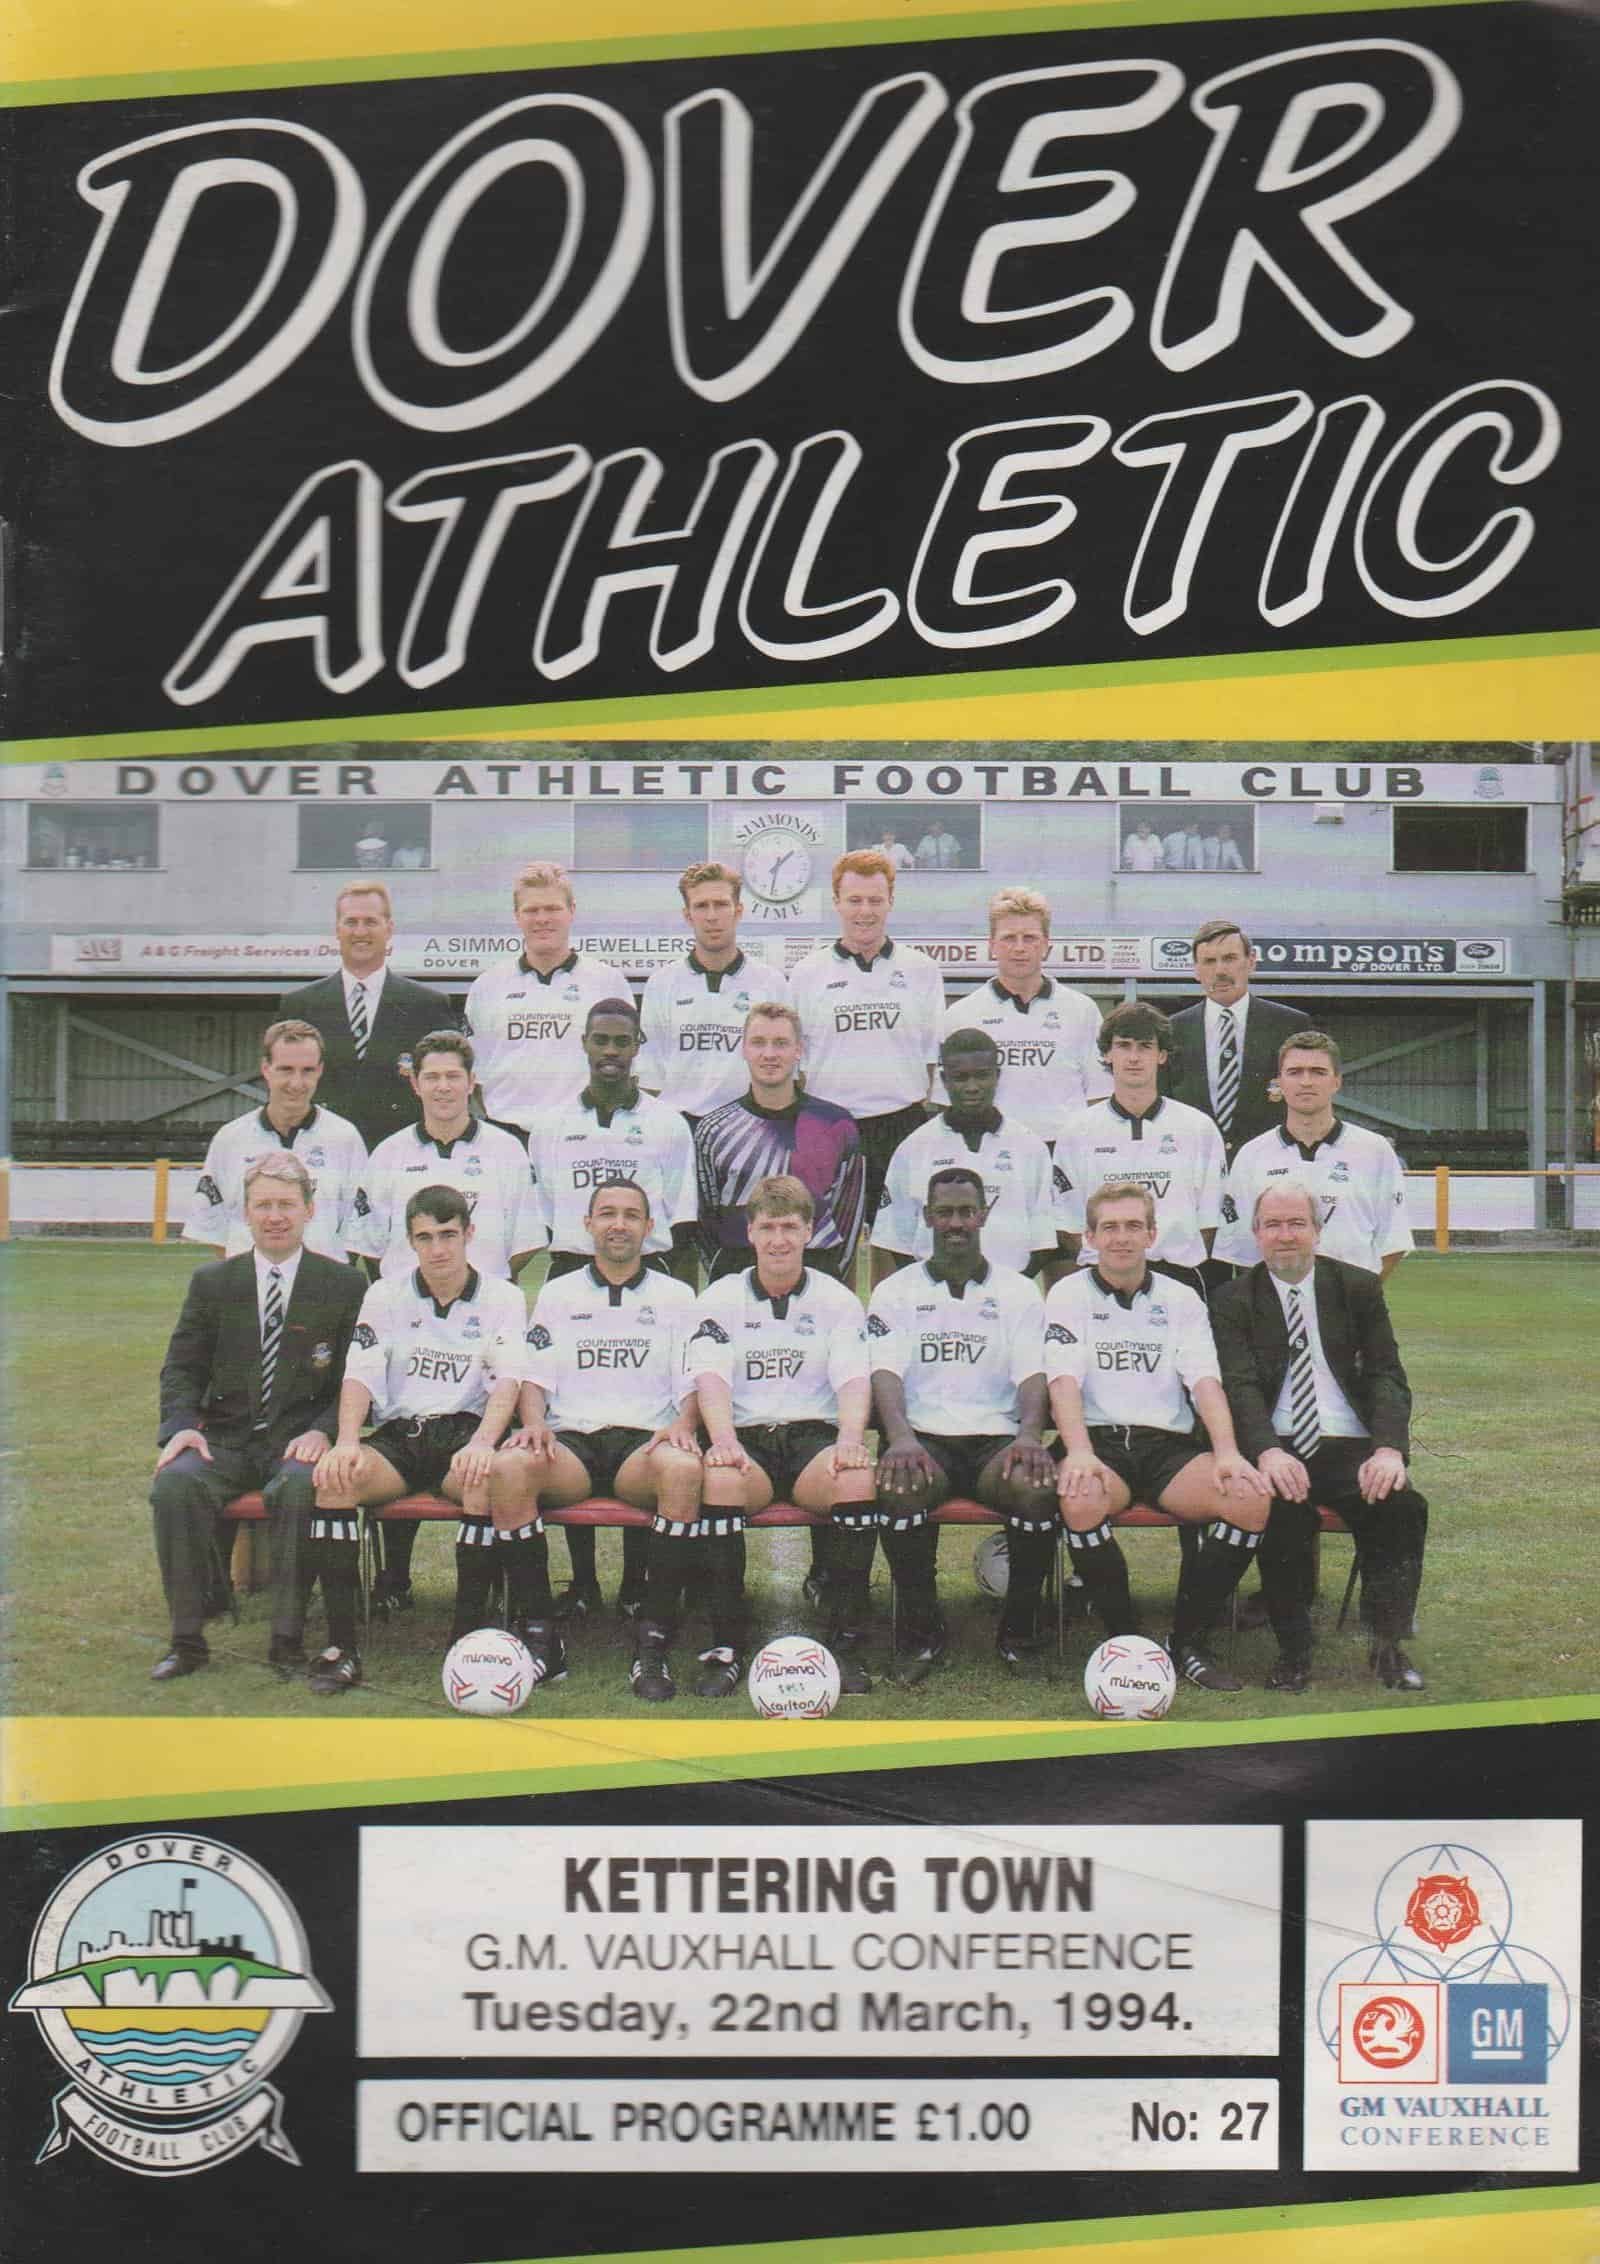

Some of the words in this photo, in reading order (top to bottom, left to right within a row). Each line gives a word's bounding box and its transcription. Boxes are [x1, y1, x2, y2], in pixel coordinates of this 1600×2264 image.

[49, 39, 1461, 447] DOVER
[163, 379, 1560, 705] ATHLETIC
[116, 765, 378, 796] DOVER
[434, 765, 786, 795] ATHLETIC
[834, 765, 1192, 796] FOOTBALL
[1240, 766, 1425, 797] CLUB
[736, 813, 821, 843] SIMMONDS
[752, 901, 803, 920] TIME
[183, 944, 241, 960] Freight
[244, 944, 311, 958] Services
[424, 938, 441, 952] A
[448, 938, 521, 952] SIMMO
[575, 938, 697, 953] JEWELLERS
[1064, 946, 1105, 962] LTD
[1249, 940, 1444, 969] hompson's
[424, 958, 480, 968] DOVER
[1350, 963, 1367, 972] OF
[1370, 963, 1411, 972] DOVER
[508, 1021, 571, 1040] DERV
[835, 1011, 900, 1033] DERV
[680, 1032, 742, 1052] DERV
[577, 1348, 649, 1369] DERV
[921, 1341, 986, 1364] DERV
[1096, 1350, 1161, 1373] DERV
[770, 1700, 816, 1712] carlton
[104, 1841, 233, 1871] DOVER
[565, 1857, 896, 1914] KETTERING
[925, 1857, 1094, 1914] TOWN
[466, 1933, 567, 1971] G.M.
[585, 1933, 836, 1971] VAUXHALL
[853, 1933, 1194, 1971] CONFERENCE
[463, 1991, 689, 2041] Tuesday,
[712, 1991, 838, 2032] 22nd
[861, 1991, 1030, 2040] March,
[1054, 1991, 1193, 2032] 1994.
[1472, 2008, 1524, 2048] GM
[76, 2057, 260, 2104] ATHLETIC
[1340, 2097, 1385, 2118] GM
[1396, 2096, 1550, 2118] VAUXHALL
[397, 2101, 593, 2142] OFFICIAL
[614, 2101, 897, 2142] PROGRAMME
[917, 2101, 1031, 2142] £1.00
[1131, 2101, 1198, 2142] No:
[1221, 2101, 1270, 2141] 27
[83, 2114, 181, 2160] FOOTBALL
[203, 2114, 249, 2152] CLUB
[1341, 2126, 1550, 2147] CONFERENCE
